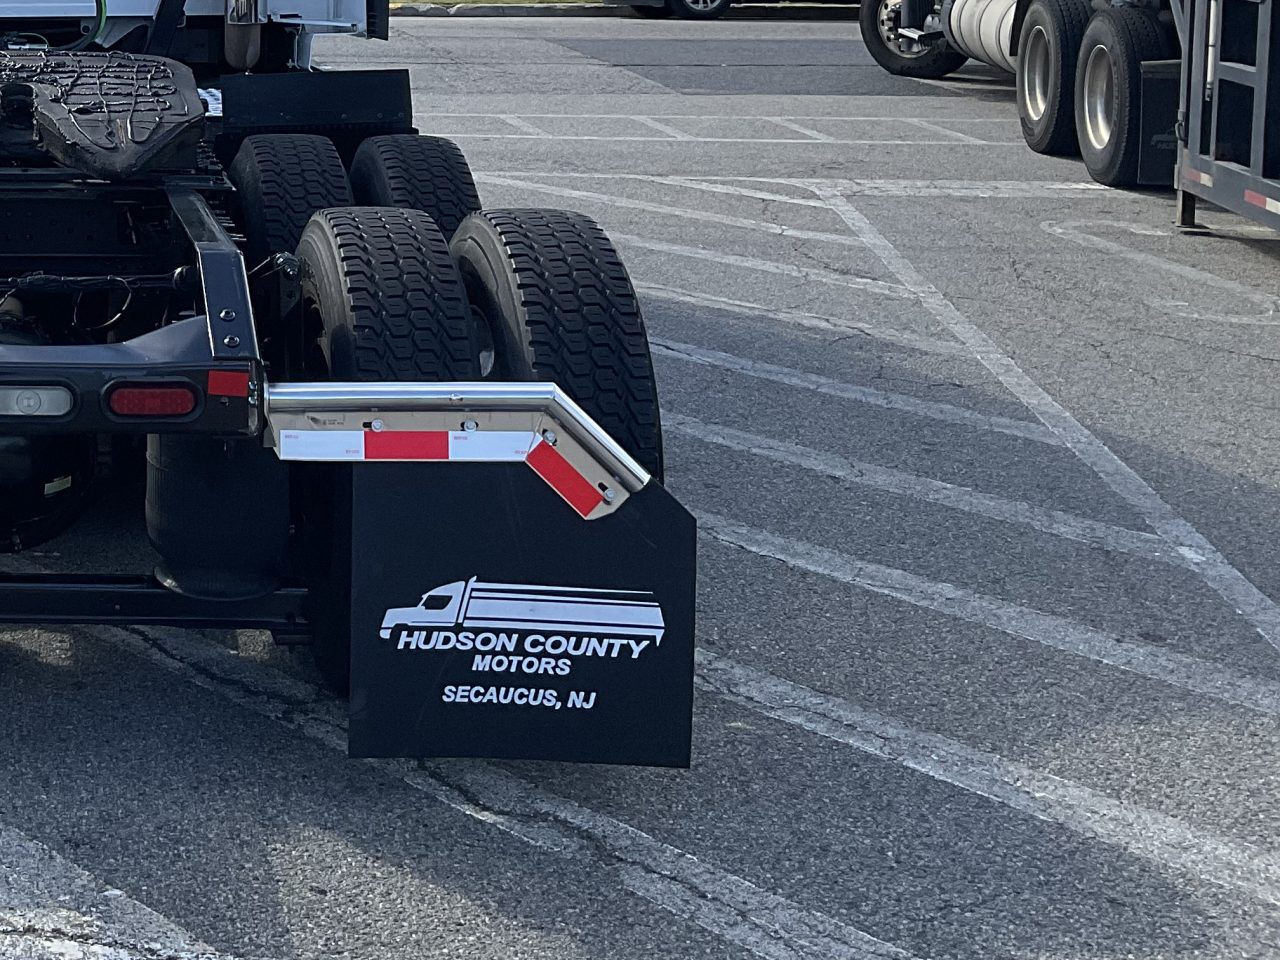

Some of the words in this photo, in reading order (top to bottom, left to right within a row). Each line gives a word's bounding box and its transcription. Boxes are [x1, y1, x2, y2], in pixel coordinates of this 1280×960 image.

[397, 630, 518, 652] HUDSON
[524, 634, 651, 659] COUNTY
[472, 655, 572, 675] MOTORS
[442, 685, 562, 710] SECAUCUS,
[567, 691, 597, 709] NJ
